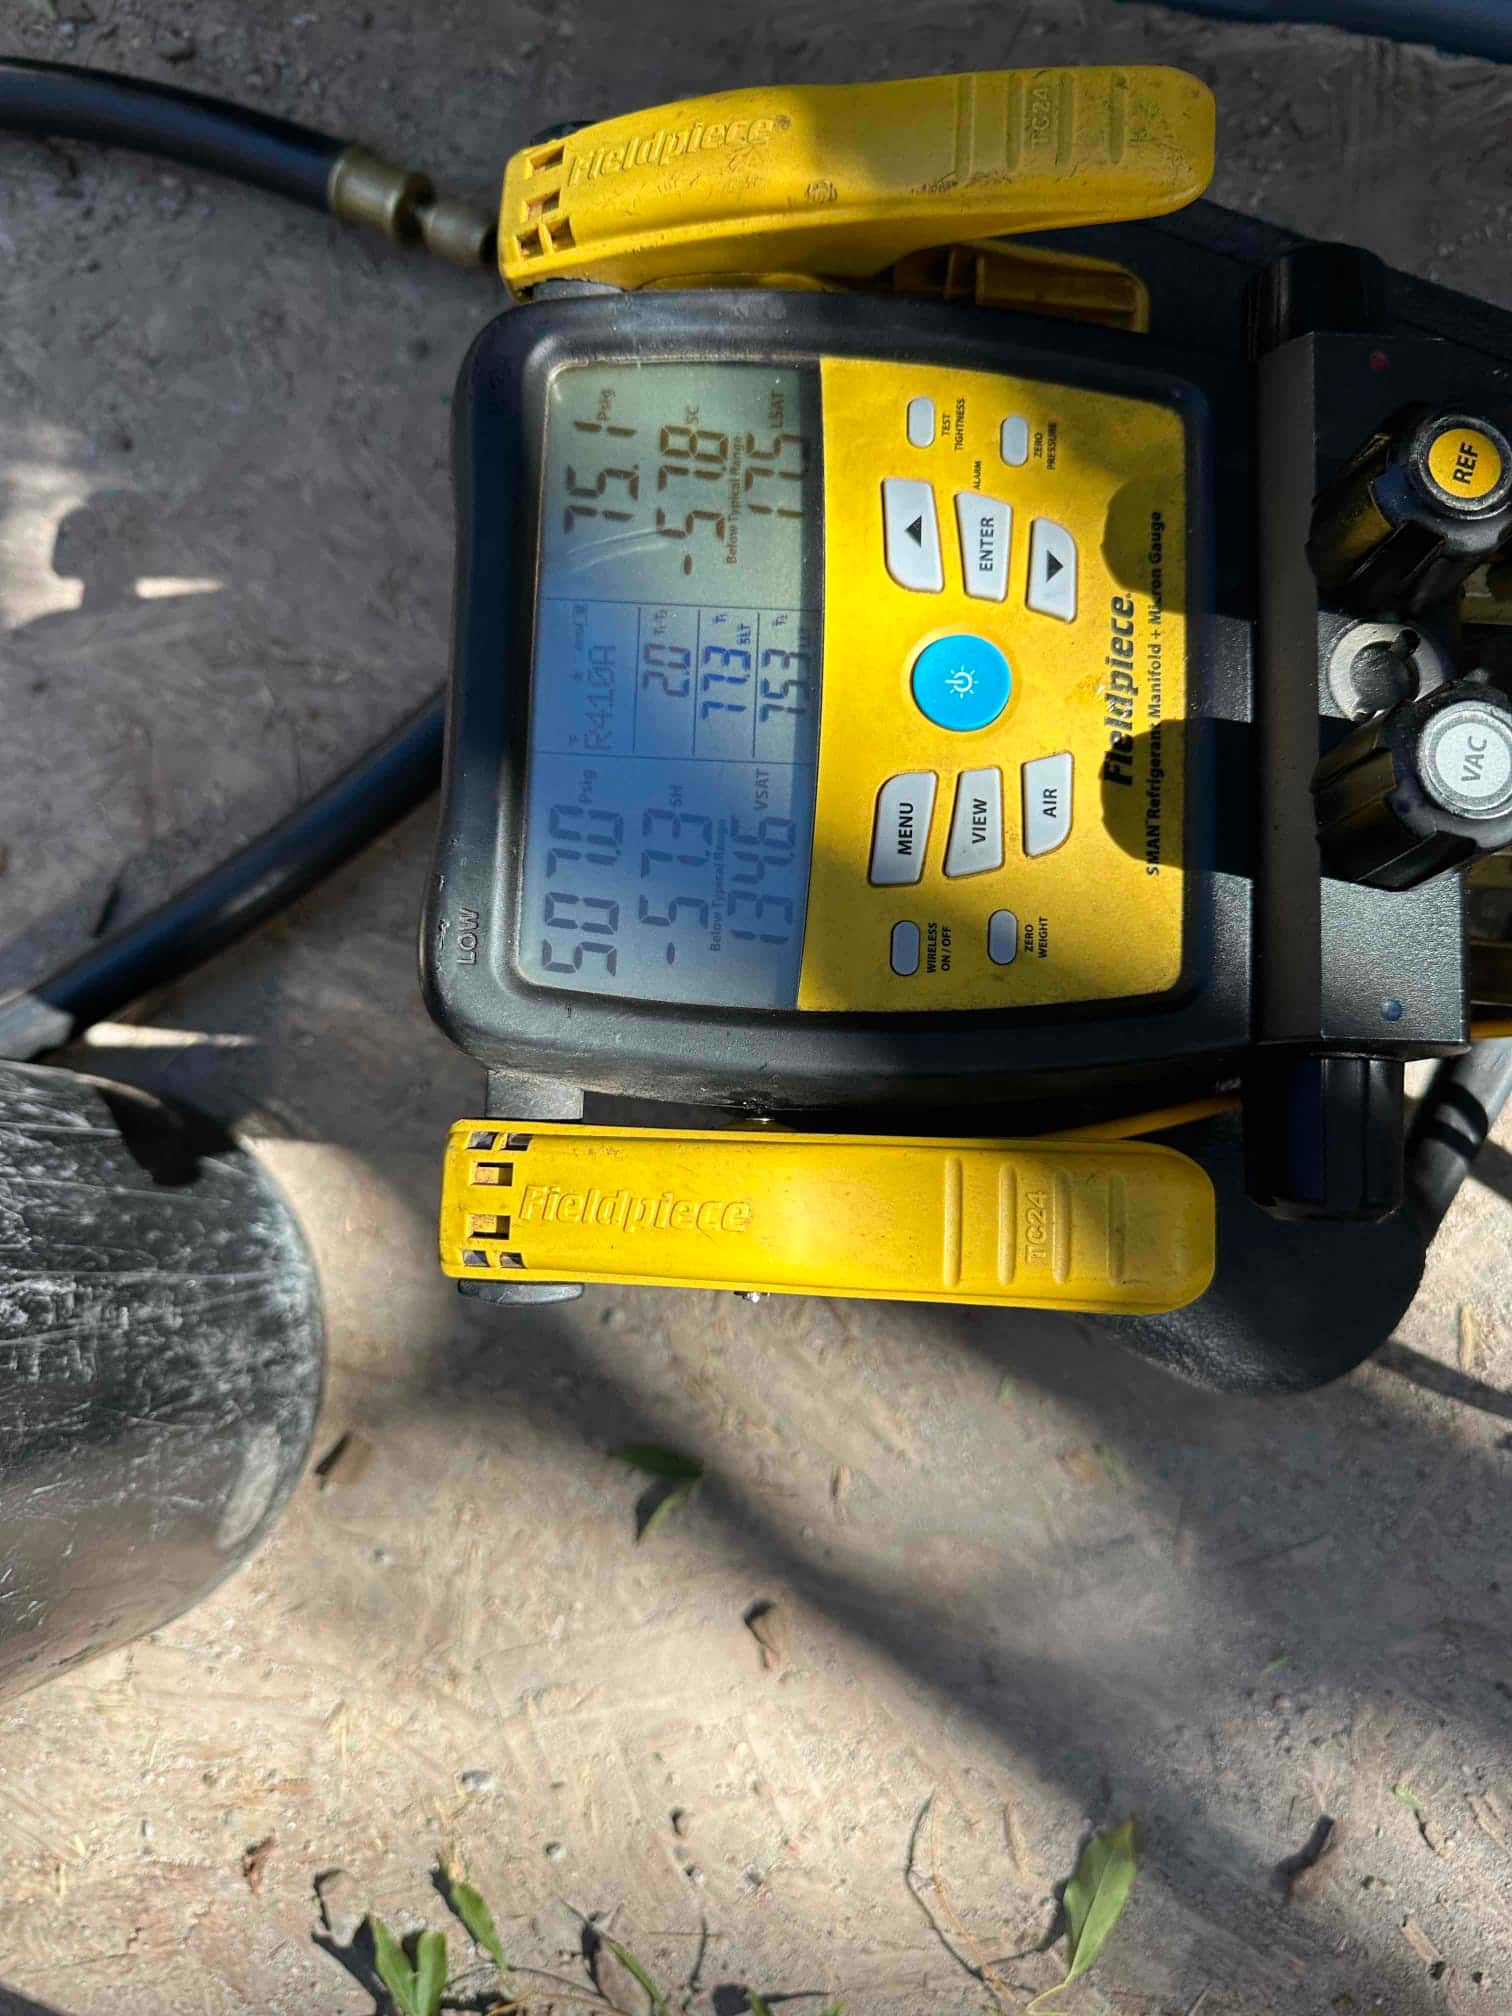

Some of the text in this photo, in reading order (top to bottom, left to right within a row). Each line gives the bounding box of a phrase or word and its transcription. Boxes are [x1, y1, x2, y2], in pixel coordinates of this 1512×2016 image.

[568, 118, 776, 188] Fieldpiece
[769, 389, 785, 429] LSAT
[941, 413, 951, 438] TEST
[954, 397, 966, 452] TIGHTNESS
[563, 388, 640, 535] 75.1 Psig
[1034, 432, 1044, 458] ZERO
[1046, 422, 1057, 471] PRESSURE
[1452, 442, 1479, 485] REF
[655, 405, 730, 576] -57.8 SC
[726, 435, 745, 565] Below Typical Range
[973, 459, 982, 490] ALARM
[979, 516, 995, 572] ENTER
[1147, 512, 1165, 564] Gauge
[1148, 569, 1162, 625] Micron
[642, 642, 691, 698] 2.0
[702, 645, 752, 721] 77.3
[1104, 595, 1139, 786] Fieldpiece
[1147, 643, 1162, 718] Manifold
[584, 645, 616, 750] R410A
[1147, 724, 1165, 819] Refrigerant
[1461, 735, 1488, 783] VAC
[753, 768, 770, 811] VSAT
[1043, 788, 1058, 819] AIR
[897, 802, 914, 856] MENU
[972, 798, 988, 845] VIEW
[542, 768, 623, 977] 507.0 Psig
[638, 784, 714, 966] -57.3 SH
[711, 862, 727, 908] Typical
[456, 906, 480, 965] LOW
[710, 911, 723, 952] Below
[927, 921, 938, 973] WIRELESS
[1024, 923, 1034, 953] ZERO
[1038, 917, 1049, 959] WEIGHT
[518, 1184, 752, 1232] Fieldpiece
[1025, 1191, 1047, 1264] TC24
